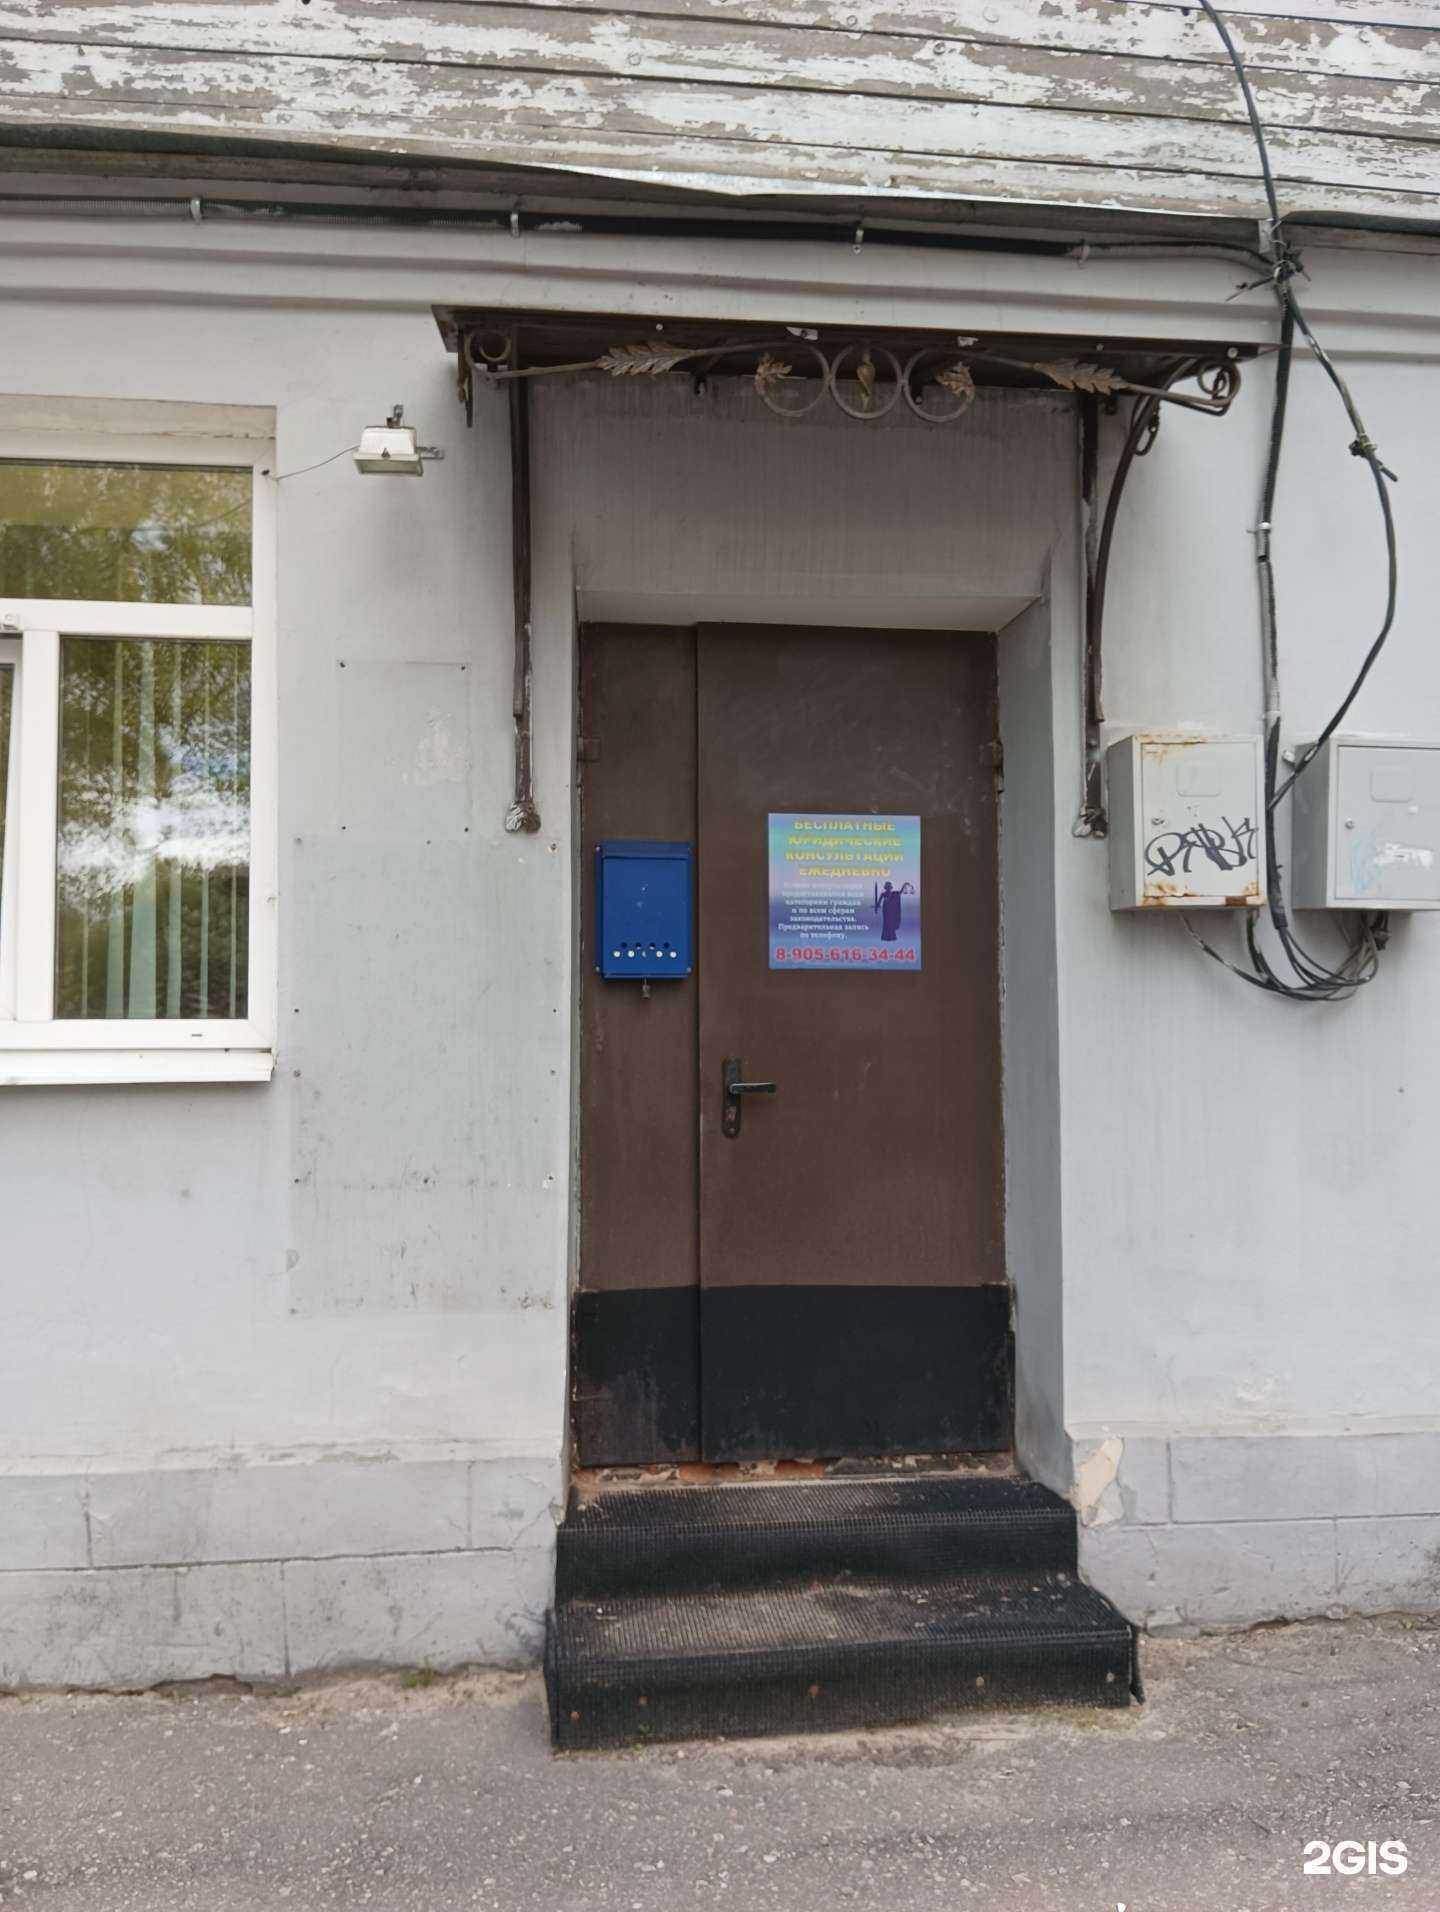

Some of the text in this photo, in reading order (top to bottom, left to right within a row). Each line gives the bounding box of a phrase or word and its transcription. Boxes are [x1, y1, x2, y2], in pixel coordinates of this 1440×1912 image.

[794, 820, 897, 831] БЕСПЛАТНЫЕ
[785, 850, 904, 862] КОНСУЛЬТАЦИИ
[799, 867, 891, 878] ЕЖЕДНЕВНО
[776, 947, 916, 962] 8-905-616-34-44
